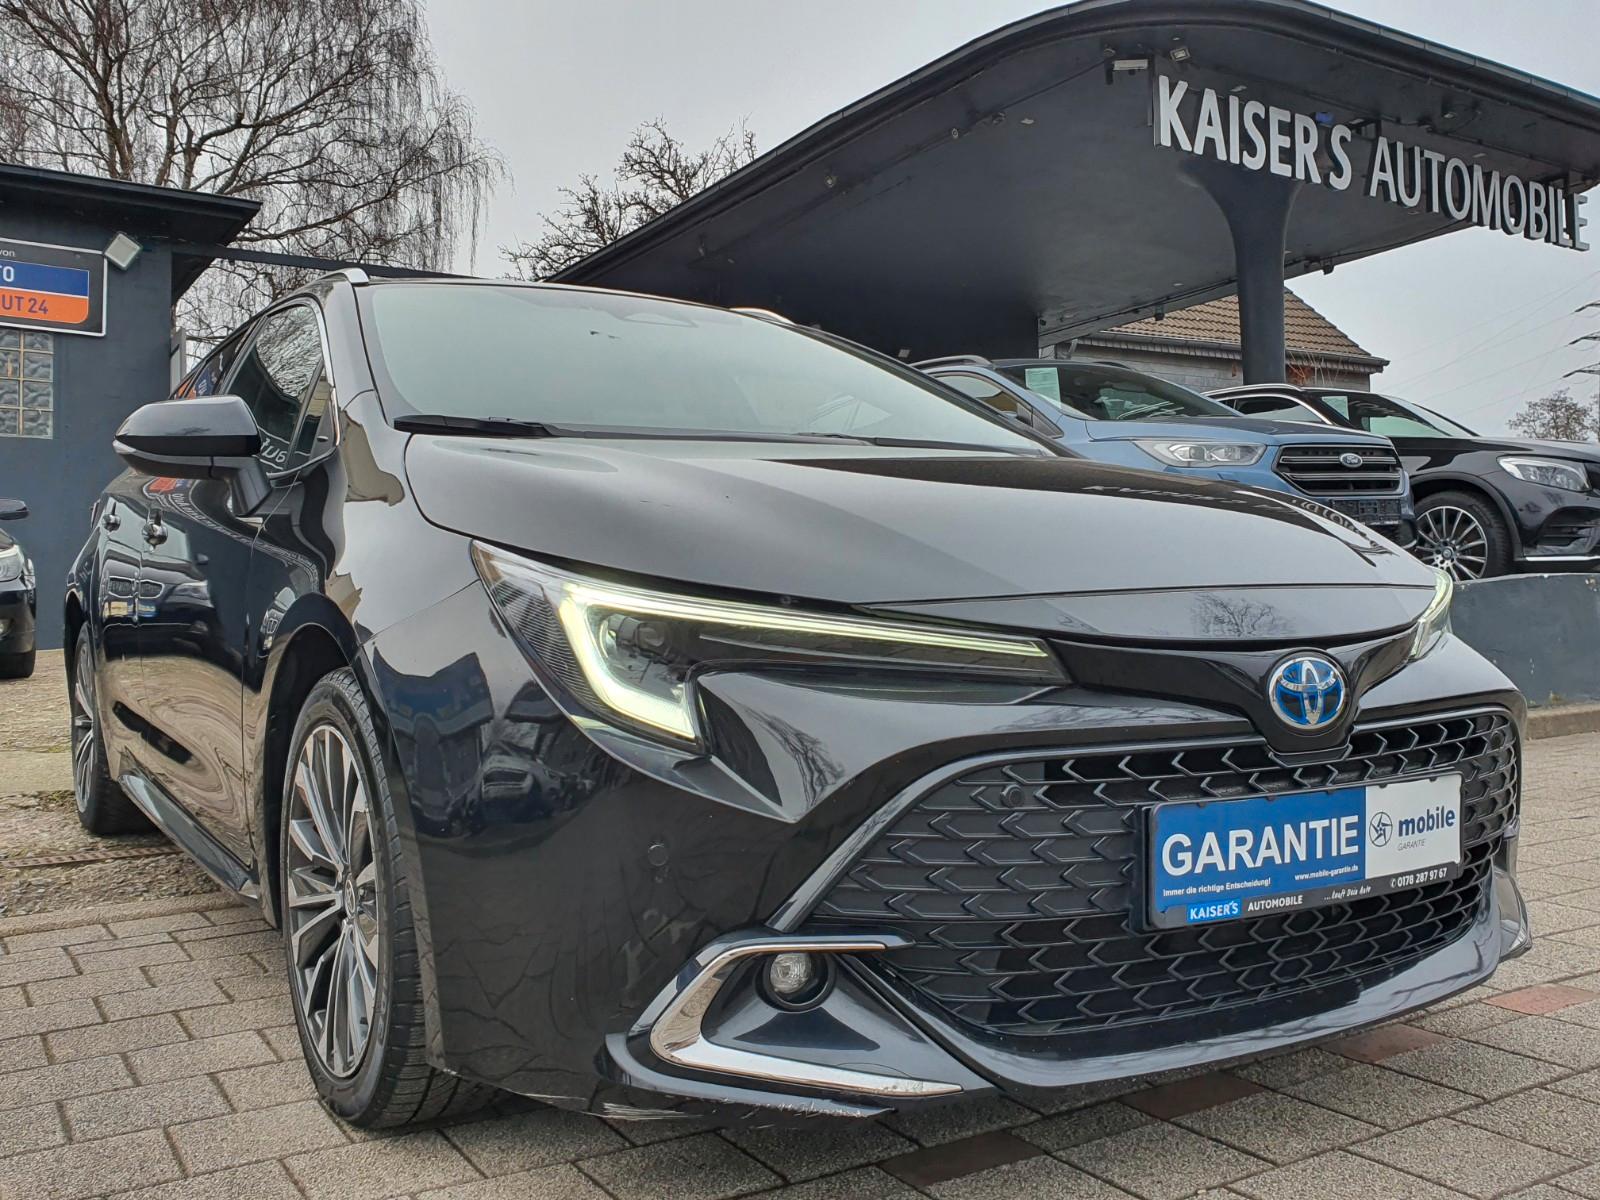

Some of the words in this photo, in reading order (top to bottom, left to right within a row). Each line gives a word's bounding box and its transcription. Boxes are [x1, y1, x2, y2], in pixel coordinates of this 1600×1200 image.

[1369, 136, 1590, 251] AUTOMOBILE
[28, 297, 48, 315] 24
[1398, 805, 1456, 837] mobile
[1162, 815, 1359, 876] GARANTIE
[1398, 839, 1426, 852] GARANTIE
[1163, 888, 1185, 897] Immer
[1186, 886, 1197, 894] die
[1198, 882, 1225, 894] richtige
[1226, 877, 1271, 890] Entscheidung!
[1397, 874, 1415, 888] 0178
[1415, 871, 1429, 884] 287
[1429, 868, 1438, 881] 97
[1438, 866, 1448, 879] 67
[1247, 895, 1304, 912] AUTOMOBILE
